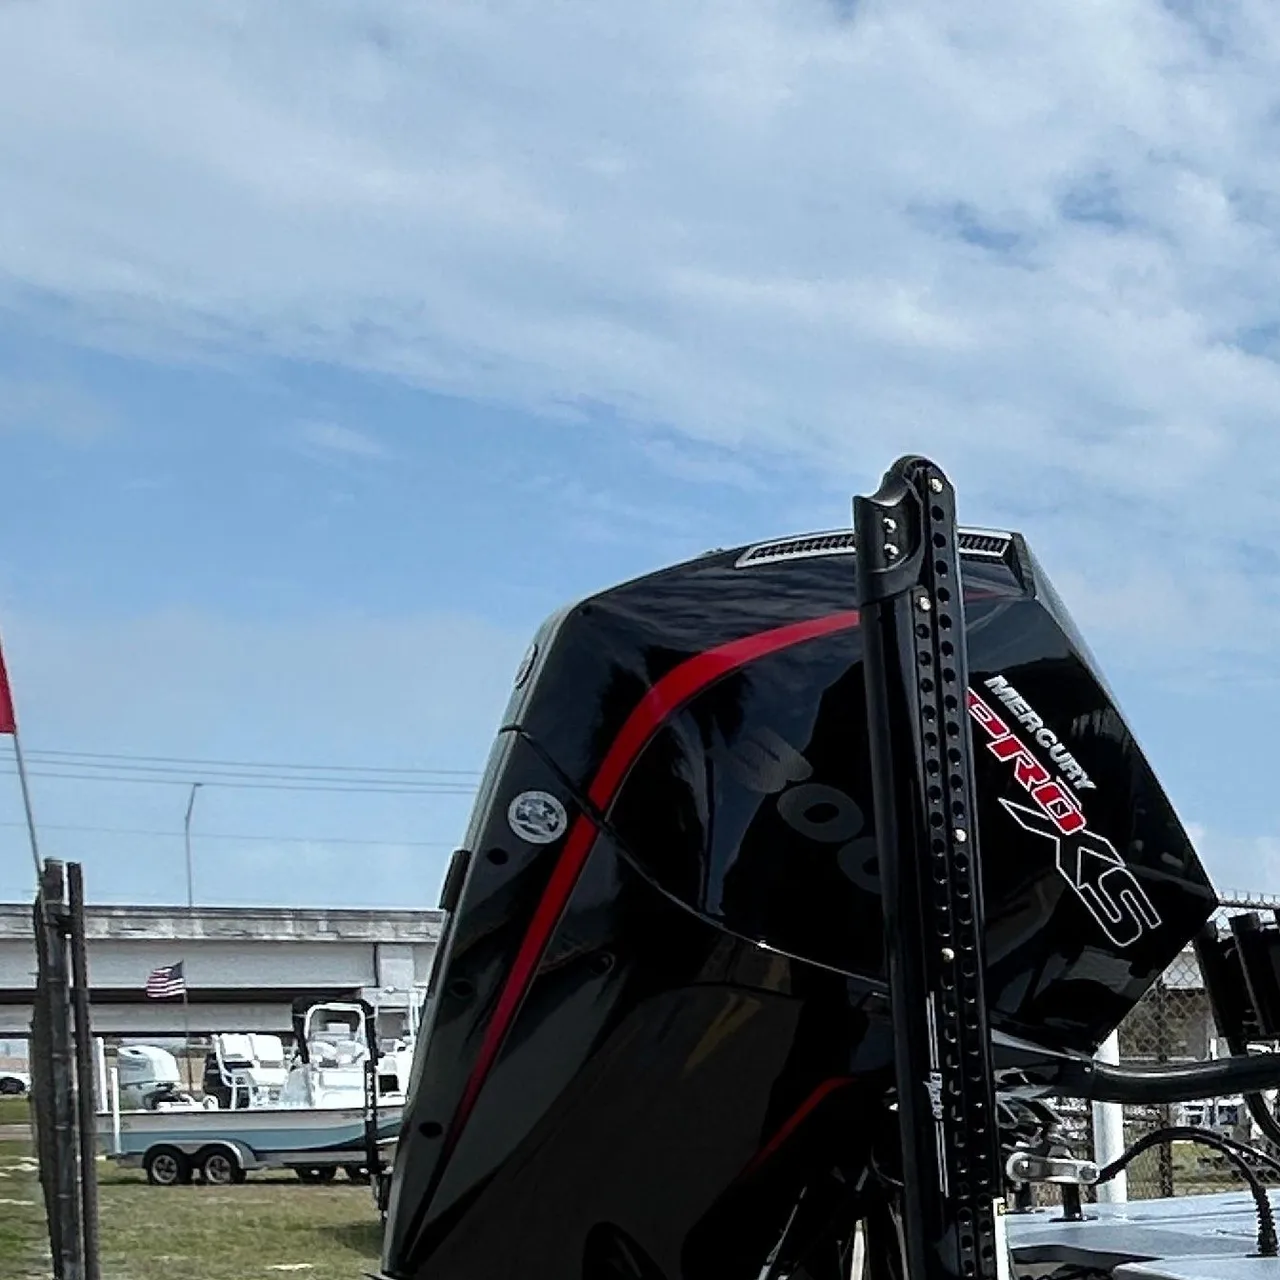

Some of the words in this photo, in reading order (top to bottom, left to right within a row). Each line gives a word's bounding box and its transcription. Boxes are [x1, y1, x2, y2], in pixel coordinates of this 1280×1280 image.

[967, 686, 1087, 836] PRO
[983, 674, 1097, 790] MERCURY
[997, 776, 1162, 947] XS
